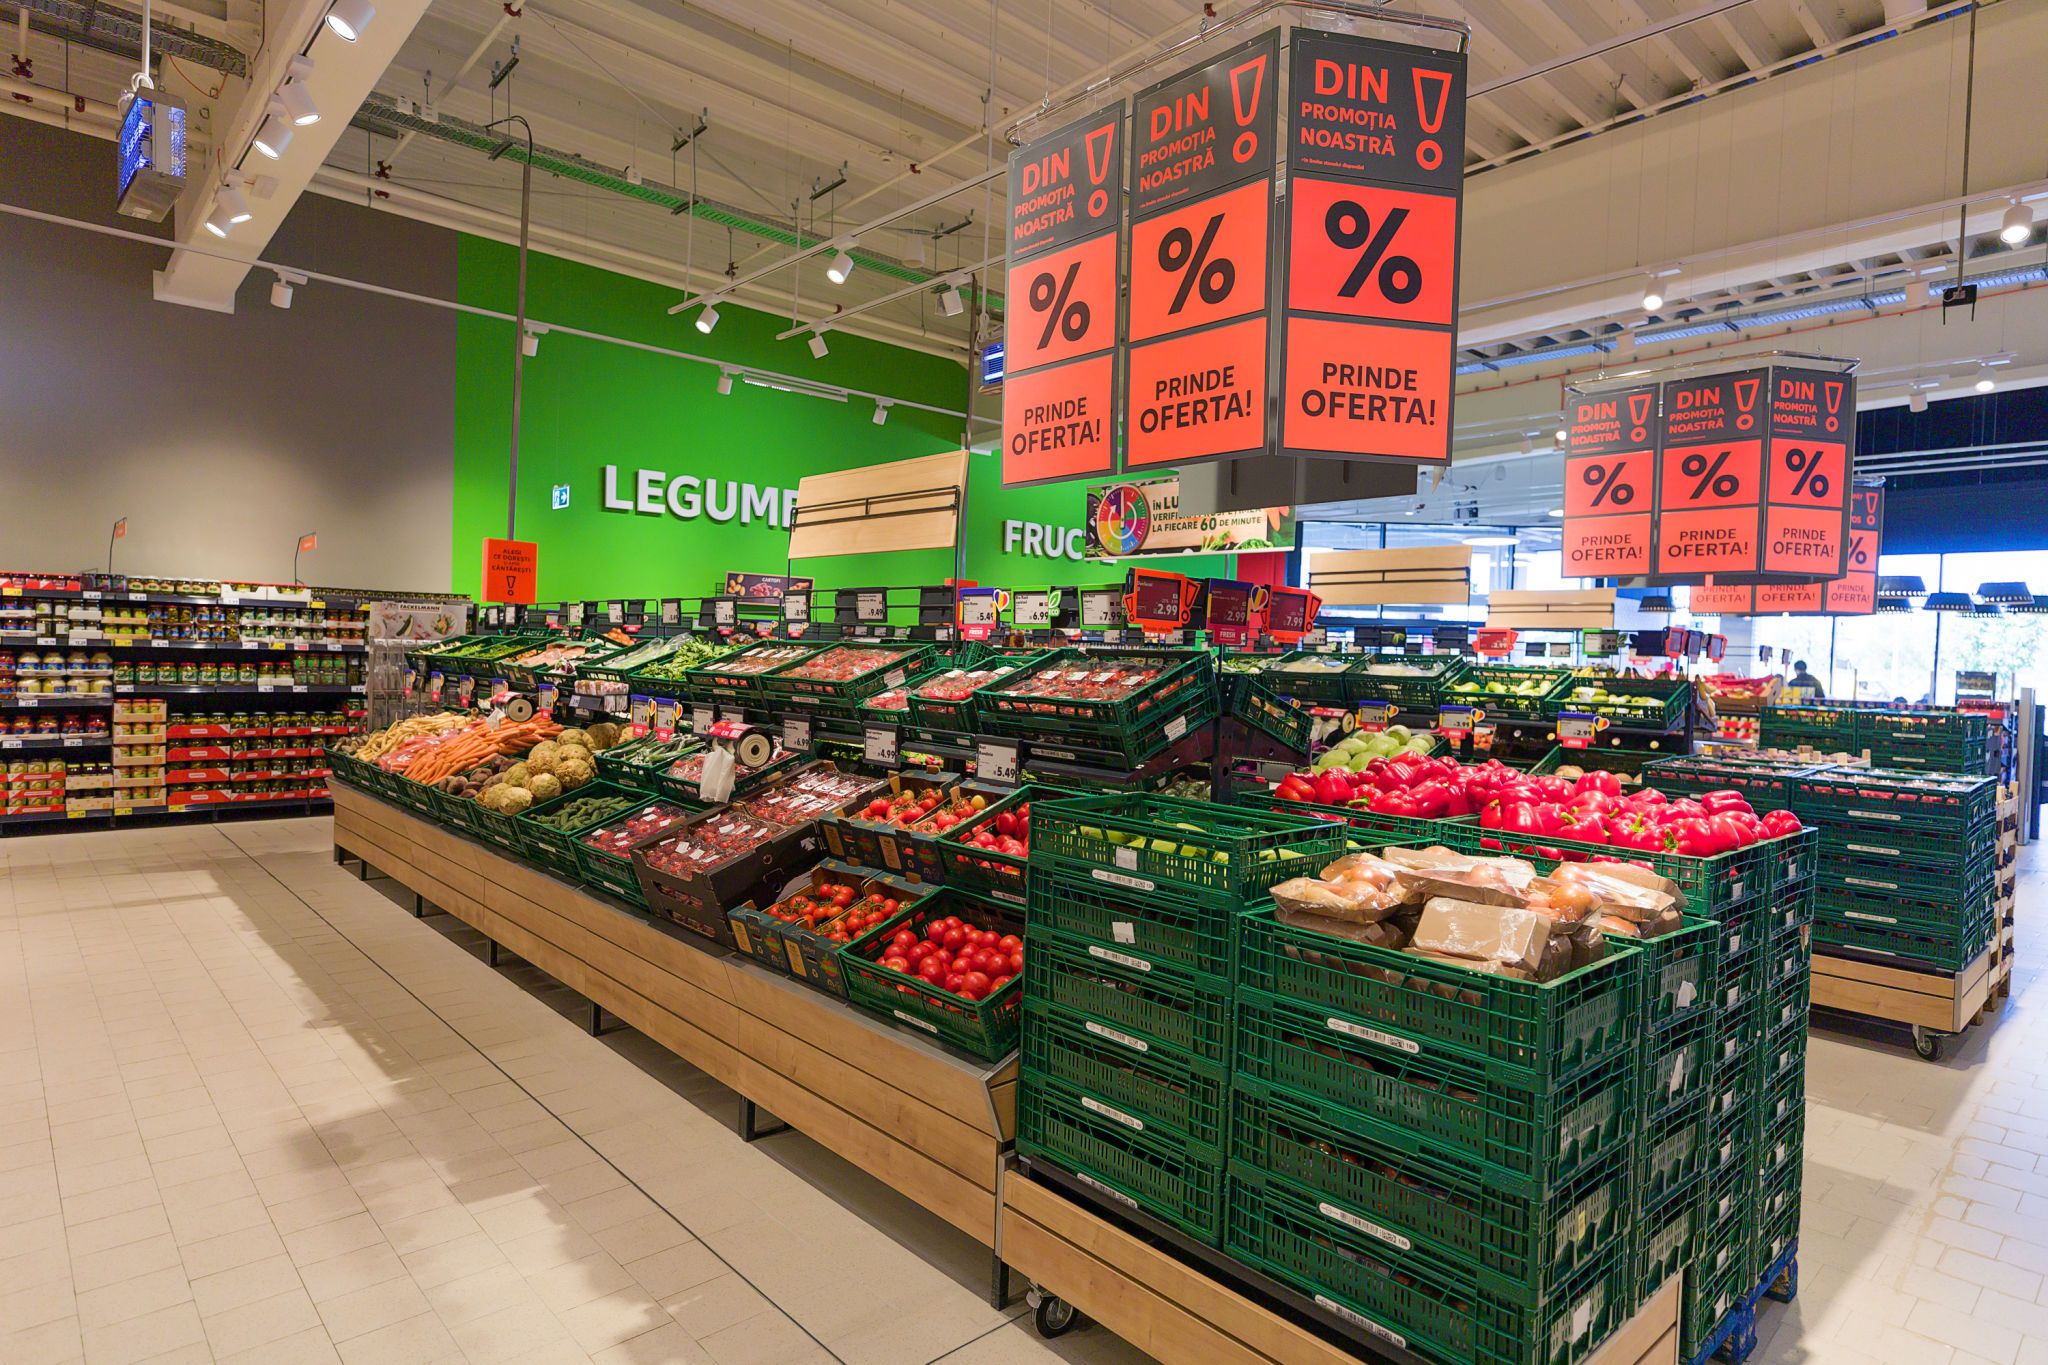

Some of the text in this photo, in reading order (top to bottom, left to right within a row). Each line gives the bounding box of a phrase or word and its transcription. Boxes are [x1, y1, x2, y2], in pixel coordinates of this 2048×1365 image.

[1315, 59, 1388, 104] DIN
[1150, 86, 1209, 142] DIN
[1301, 102, 1397, 130] PROMOȚIA
[1141, 126, 1216, 168] PROMOȚIA
[1301, 127, 1396, 156] NOASTRĂ
[1022, 147, 1070, 195] DIN
[1140, 146, 1215, 192] NOASTRĂ
[1015, 183, 1075, 219] PROMOȚIA
[1014, 201, 1075, 240] NOASTRĂ
[1325, 200, 1422, 304] %
[1158, 213, 1235, 315] %
[1029, 261, 1090, 350] %
[1155, 365, 1235, 401] PRINDE
[1322, 362, 1417, 391] PRINDE
[1676, 386, 1720, 409] DIN
[1780, 380, 1815, 400] DIN
[1024, 397, 1087, 426] PRINDE
[1140, 390, 1252, 433] OFERTA!
[1301, 389, 1436, 426] OFERTA!
[1577, 401, 1617, 423] DIN
[1669, 416, 1725, 434] NOASTRĂ
[1773, 413, 1817, 426] NOASTRĂ
[1012, 418, 1101, 455] OFERTA!
[1571, 430, 1621, 446] NOASTRĂ
[1682, 451, 1739, 499] %
[1786, 448, 1829, 498] %
[1583, 462, 1634, 507] %
[1152, 525, 1163, 533] LA
[1165, 521, 1198, 531] FIECARE
[1200, 517, 1217, 531] 60
[1231, 517, 1261, 526] MINUTE
[1680, 528, 1737, 541] PRINDE
[1783, 528, 1826, 541] PRINDE
[1005, 519, 1086, 560] FRUC
[1581, 533, 1632, 548] PRINDE
[1668, 541, 1748, 557] OFERTA!
[1773, 541, 1834, 558] OFERTA!
[1571, 545, 1643, 561] OFERTA!
[1695, 594, 1746, 603] OFERTA!
[1761, 592, 1816, 602] OFERTA!
[1831, 593, 1870, 603] OFERTA!
[1837, 584, 1865, 592] PRINDE
[1032, 612, 1049, 620] 6.99
[1102, 612, 1121, 621] 7.99
[1157, 604, 1178, 616] 2.99
[1227, 611, 1246, 622] 2.99
[1286, 616, 1303, 627] 7.99
[881, 749, 896, 759] 4.99
[997, 766, 1016, 778] 5.49
